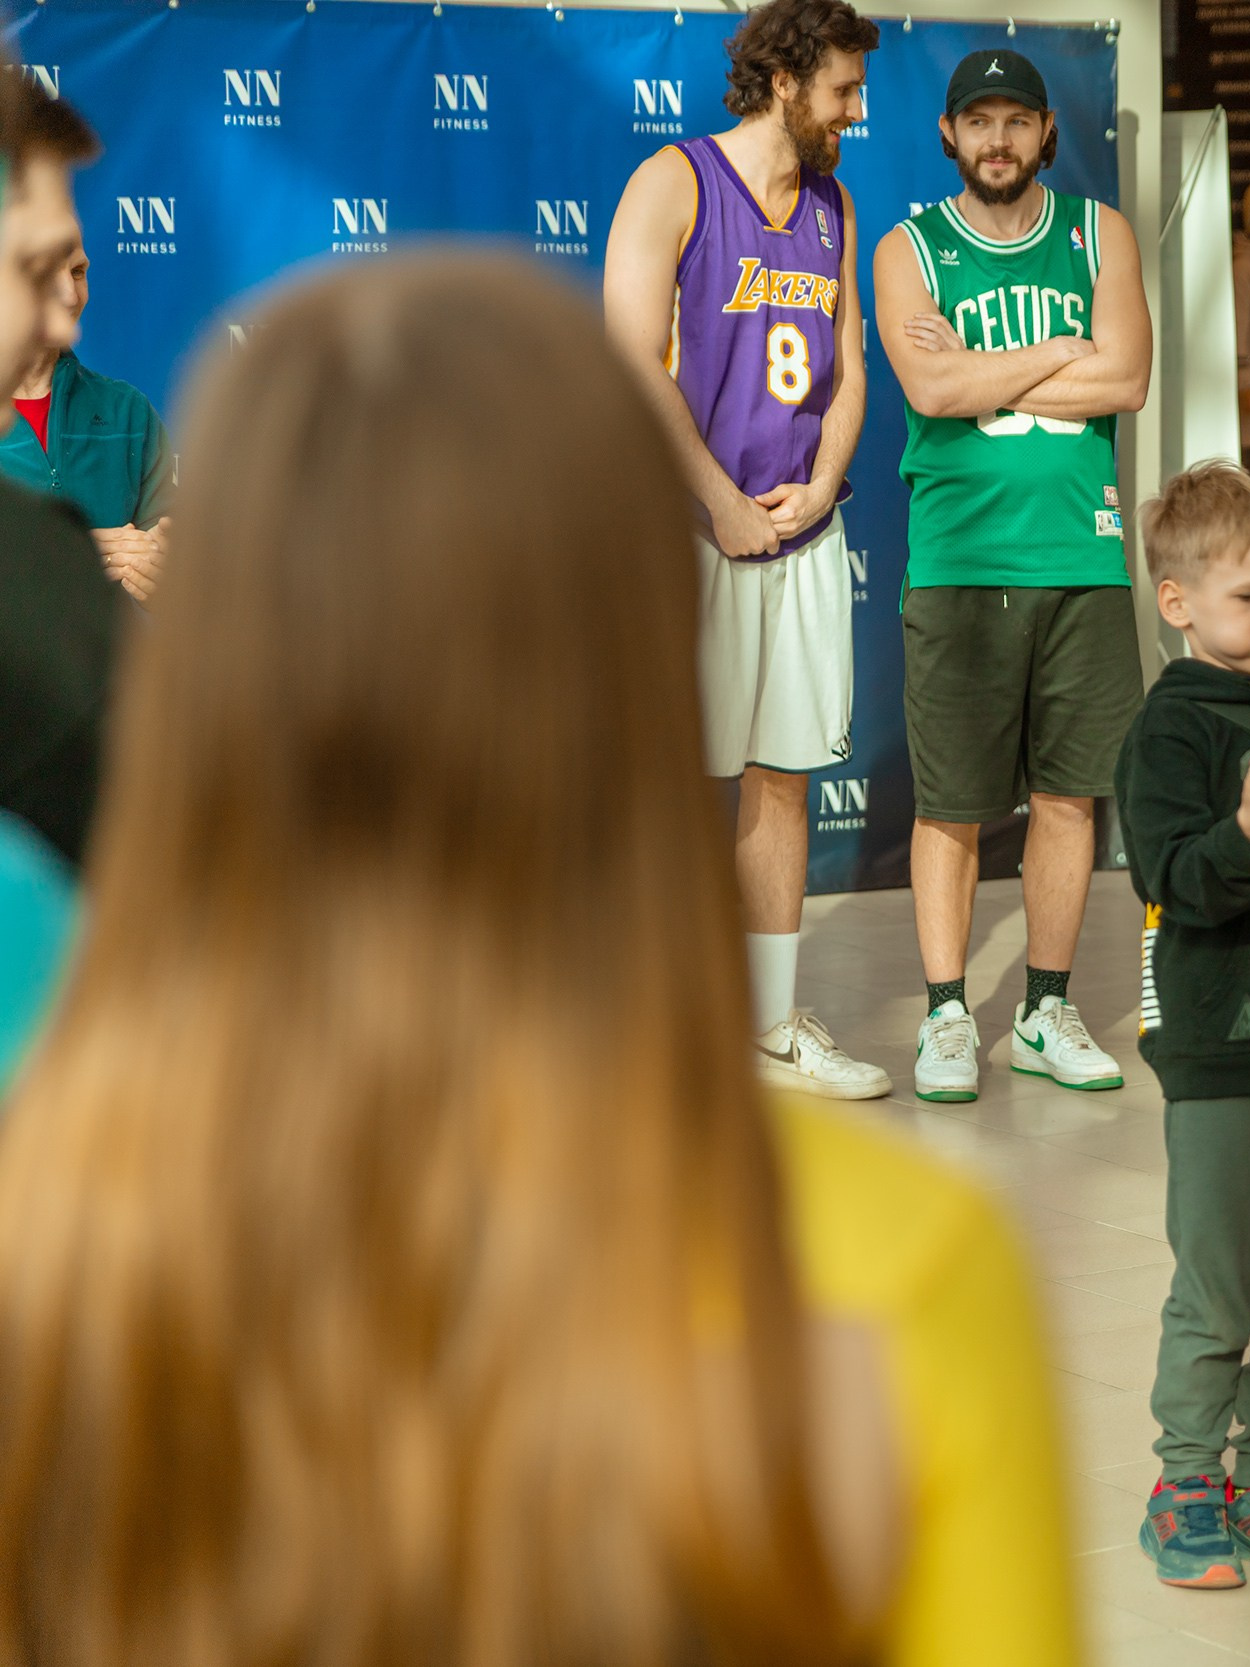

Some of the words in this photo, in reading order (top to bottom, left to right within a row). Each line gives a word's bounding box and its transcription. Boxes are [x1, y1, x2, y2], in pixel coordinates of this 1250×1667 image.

[4, 64, 60, 100] N
[223, 69, 281, 106] NN
[434, 73, 488, 111] NN
[633, 79, 683, 116] NN
[224, 114, 281, 126] FITNESS
[433, 118, 488, 130] FITNESS
[633, 122, 683, 134] FITNESS
[116, 196, 176, 234] NN
[332, 198, 388, 234] NN
[535, 200, 588, 235] NN
[117, 242, 177, 254] FITNESS
[332, 242, 388, 253] FITNESS
[535, 243, 588, 254] FITNESS
[722, 257, 839, 318] LAKERS
[955, 285, 1084, 352] CELTICS
[767, 322, 812, 405] 8
[819, 778, 869, 815] NN
[817, 817, 867, 832] FITNESS
